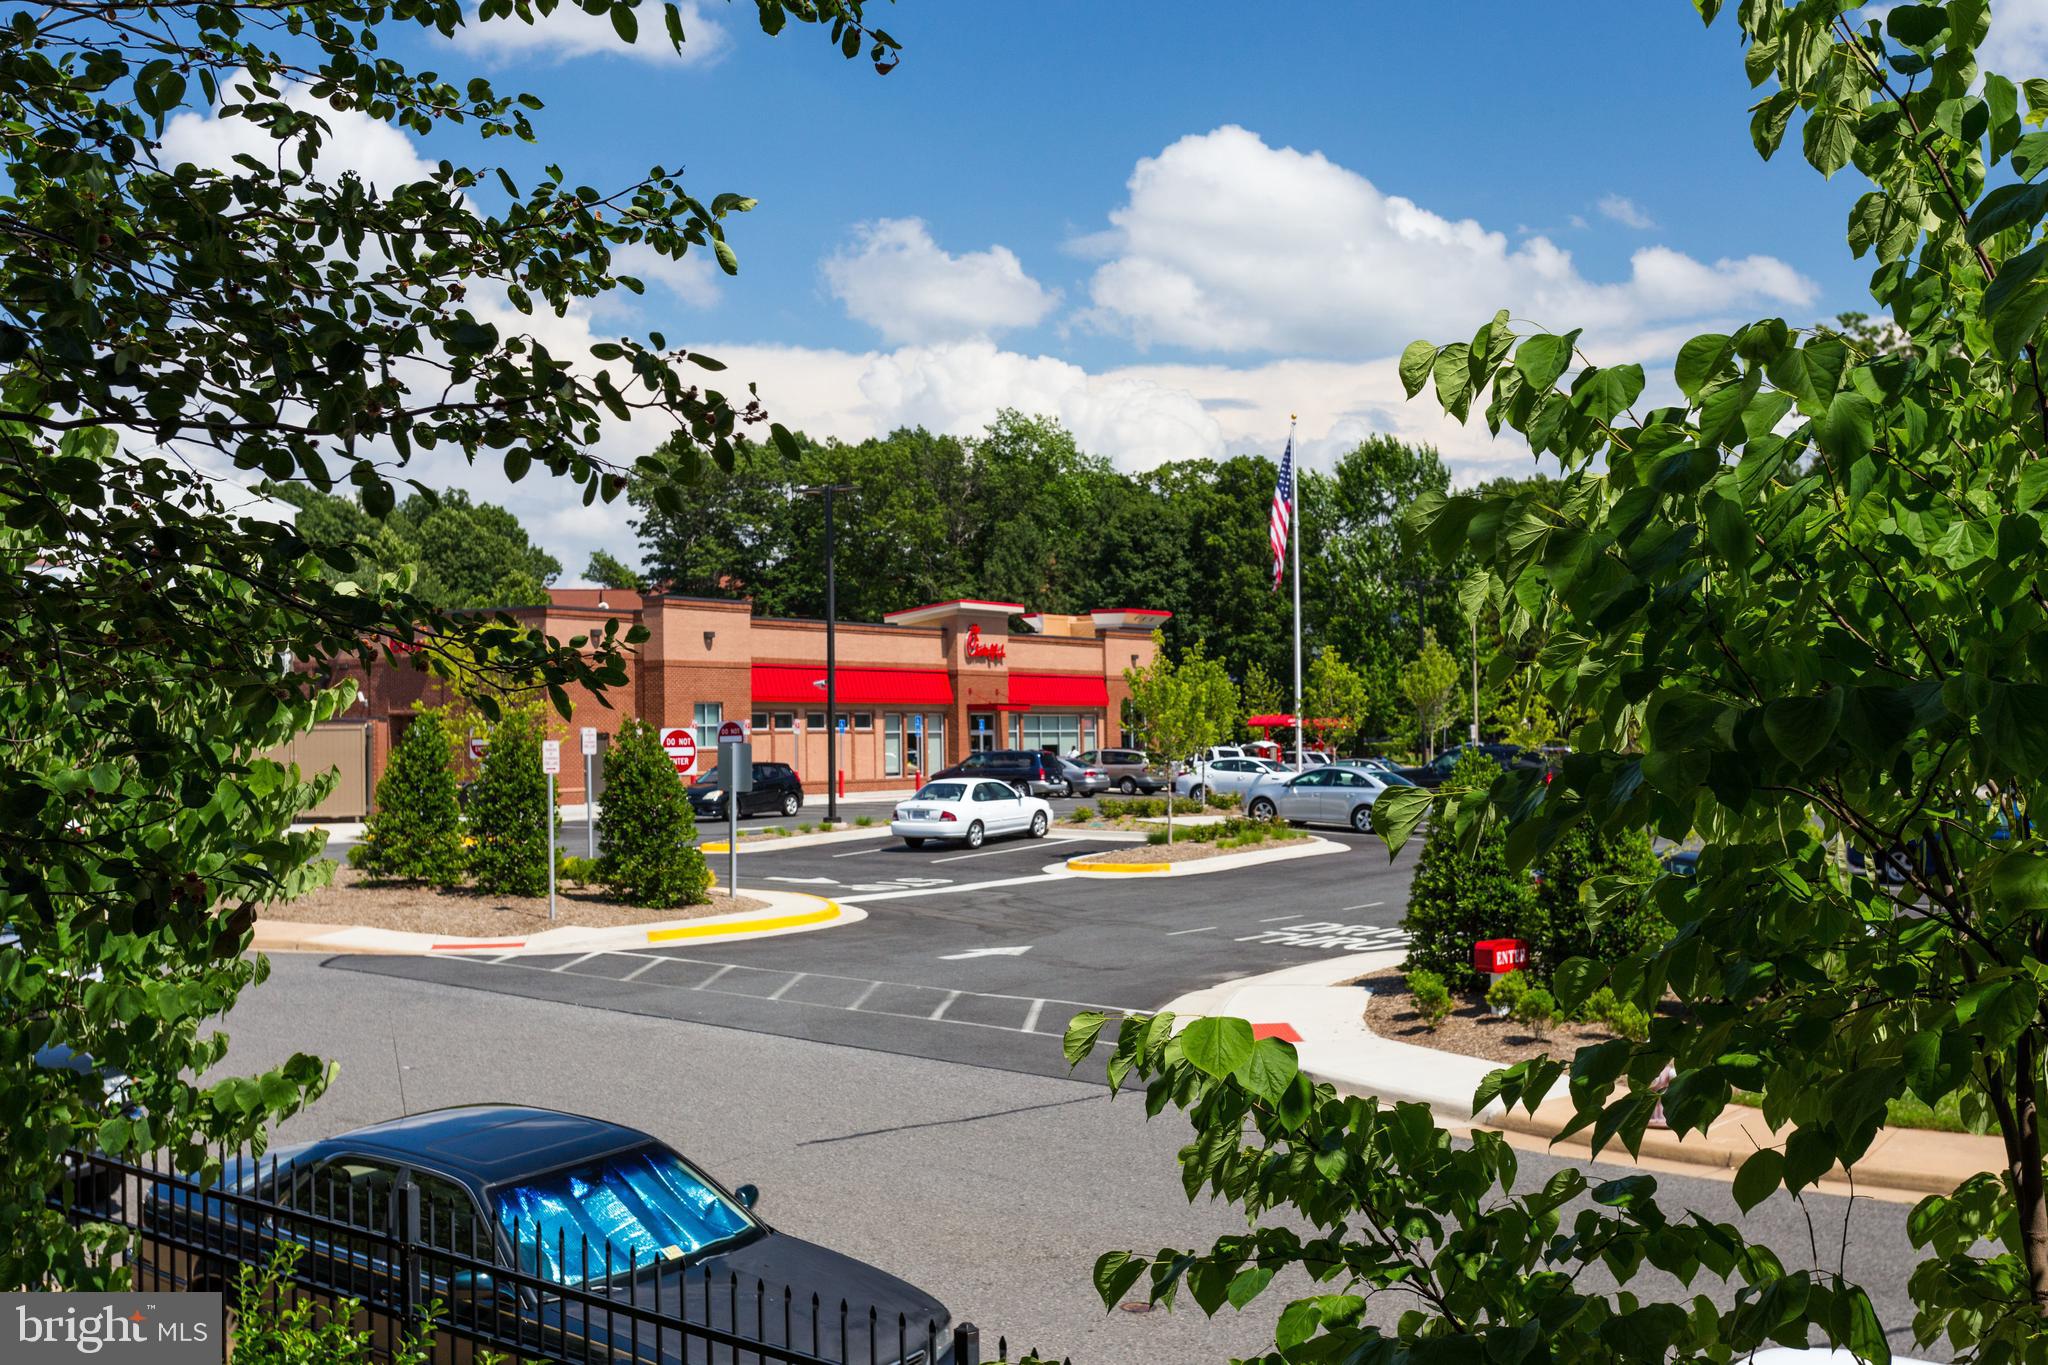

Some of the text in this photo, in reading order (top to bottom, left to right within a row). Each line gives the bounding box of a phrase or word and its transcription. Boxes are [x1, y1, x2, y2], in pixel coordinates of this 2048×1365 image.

[666, 738, 691, 746] DO NOT
[1280, 922, 1417, 940] DRIV
[1234, 931, 1412, 950] THRU
[1496, 948, 1526, 966] ENTER
